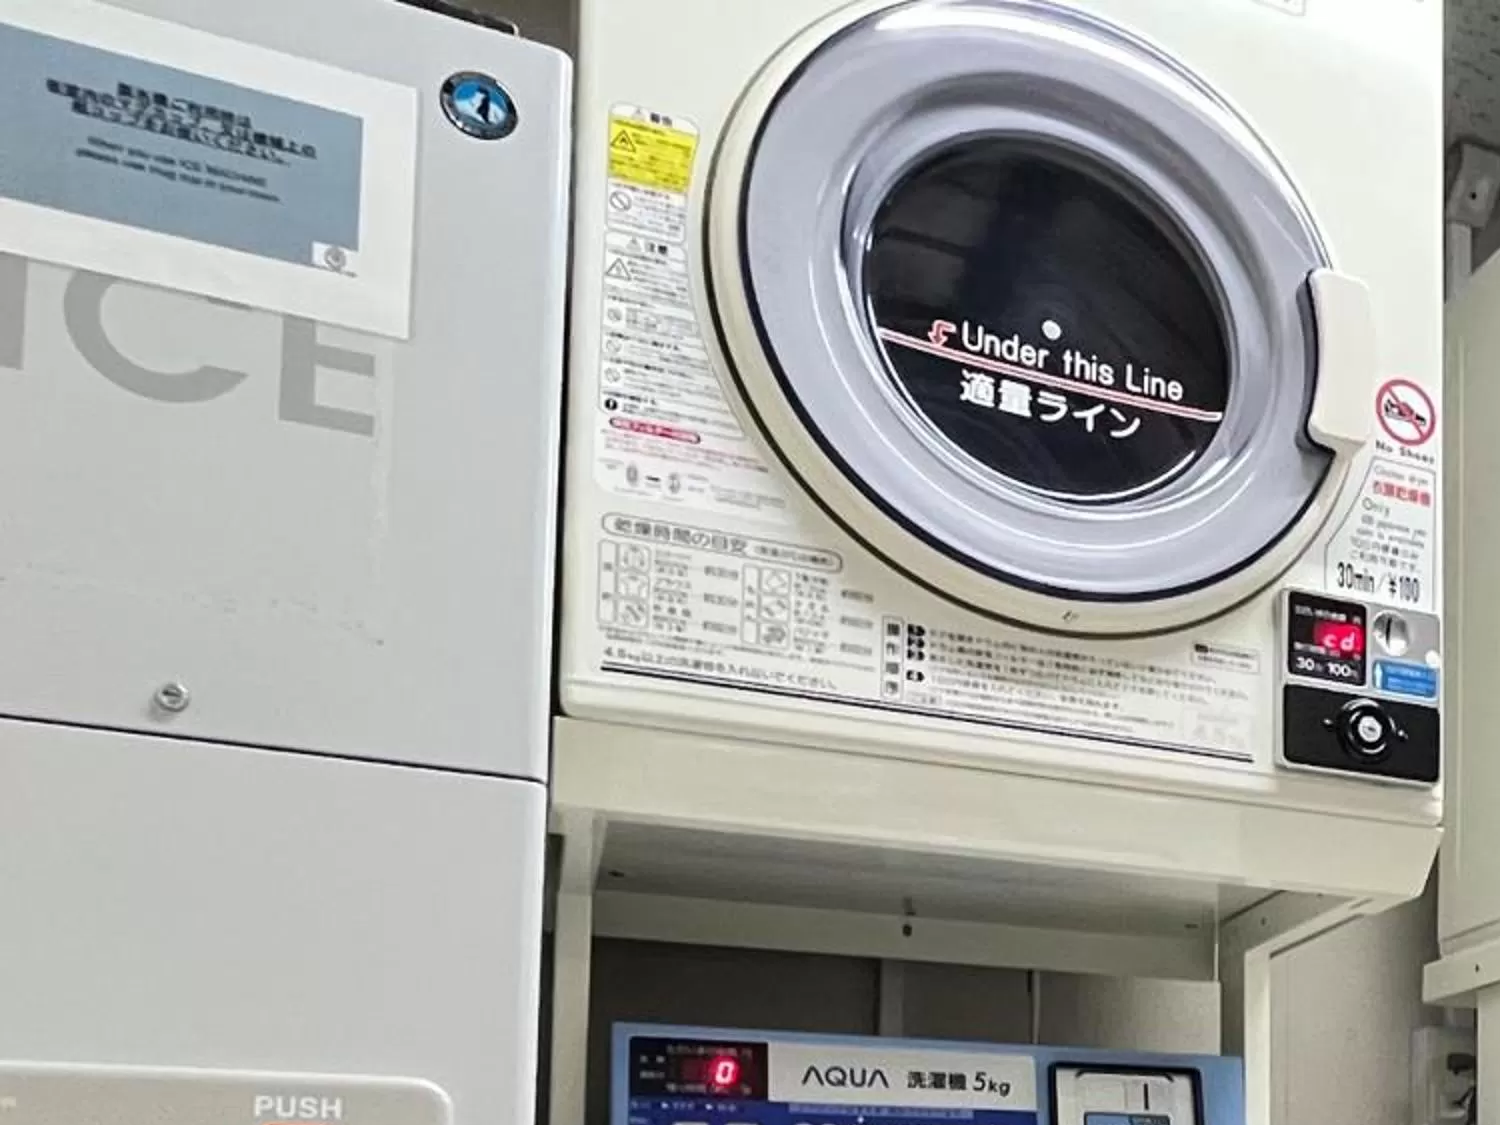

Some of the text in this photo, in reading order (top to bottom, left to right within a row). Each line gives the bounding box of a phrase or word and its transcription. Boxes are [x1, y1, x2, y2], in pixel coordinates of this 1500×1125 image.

[961, 320, 1184, 402] Under this Line
[959, 368, 1141, 439] 適量ライン
[715, 1060, 736, 1084] 0
[801, 1065, 1011, 1098] AQUA 洗濯機 5kg
[253, 1095, 342, 1120] PUSH
